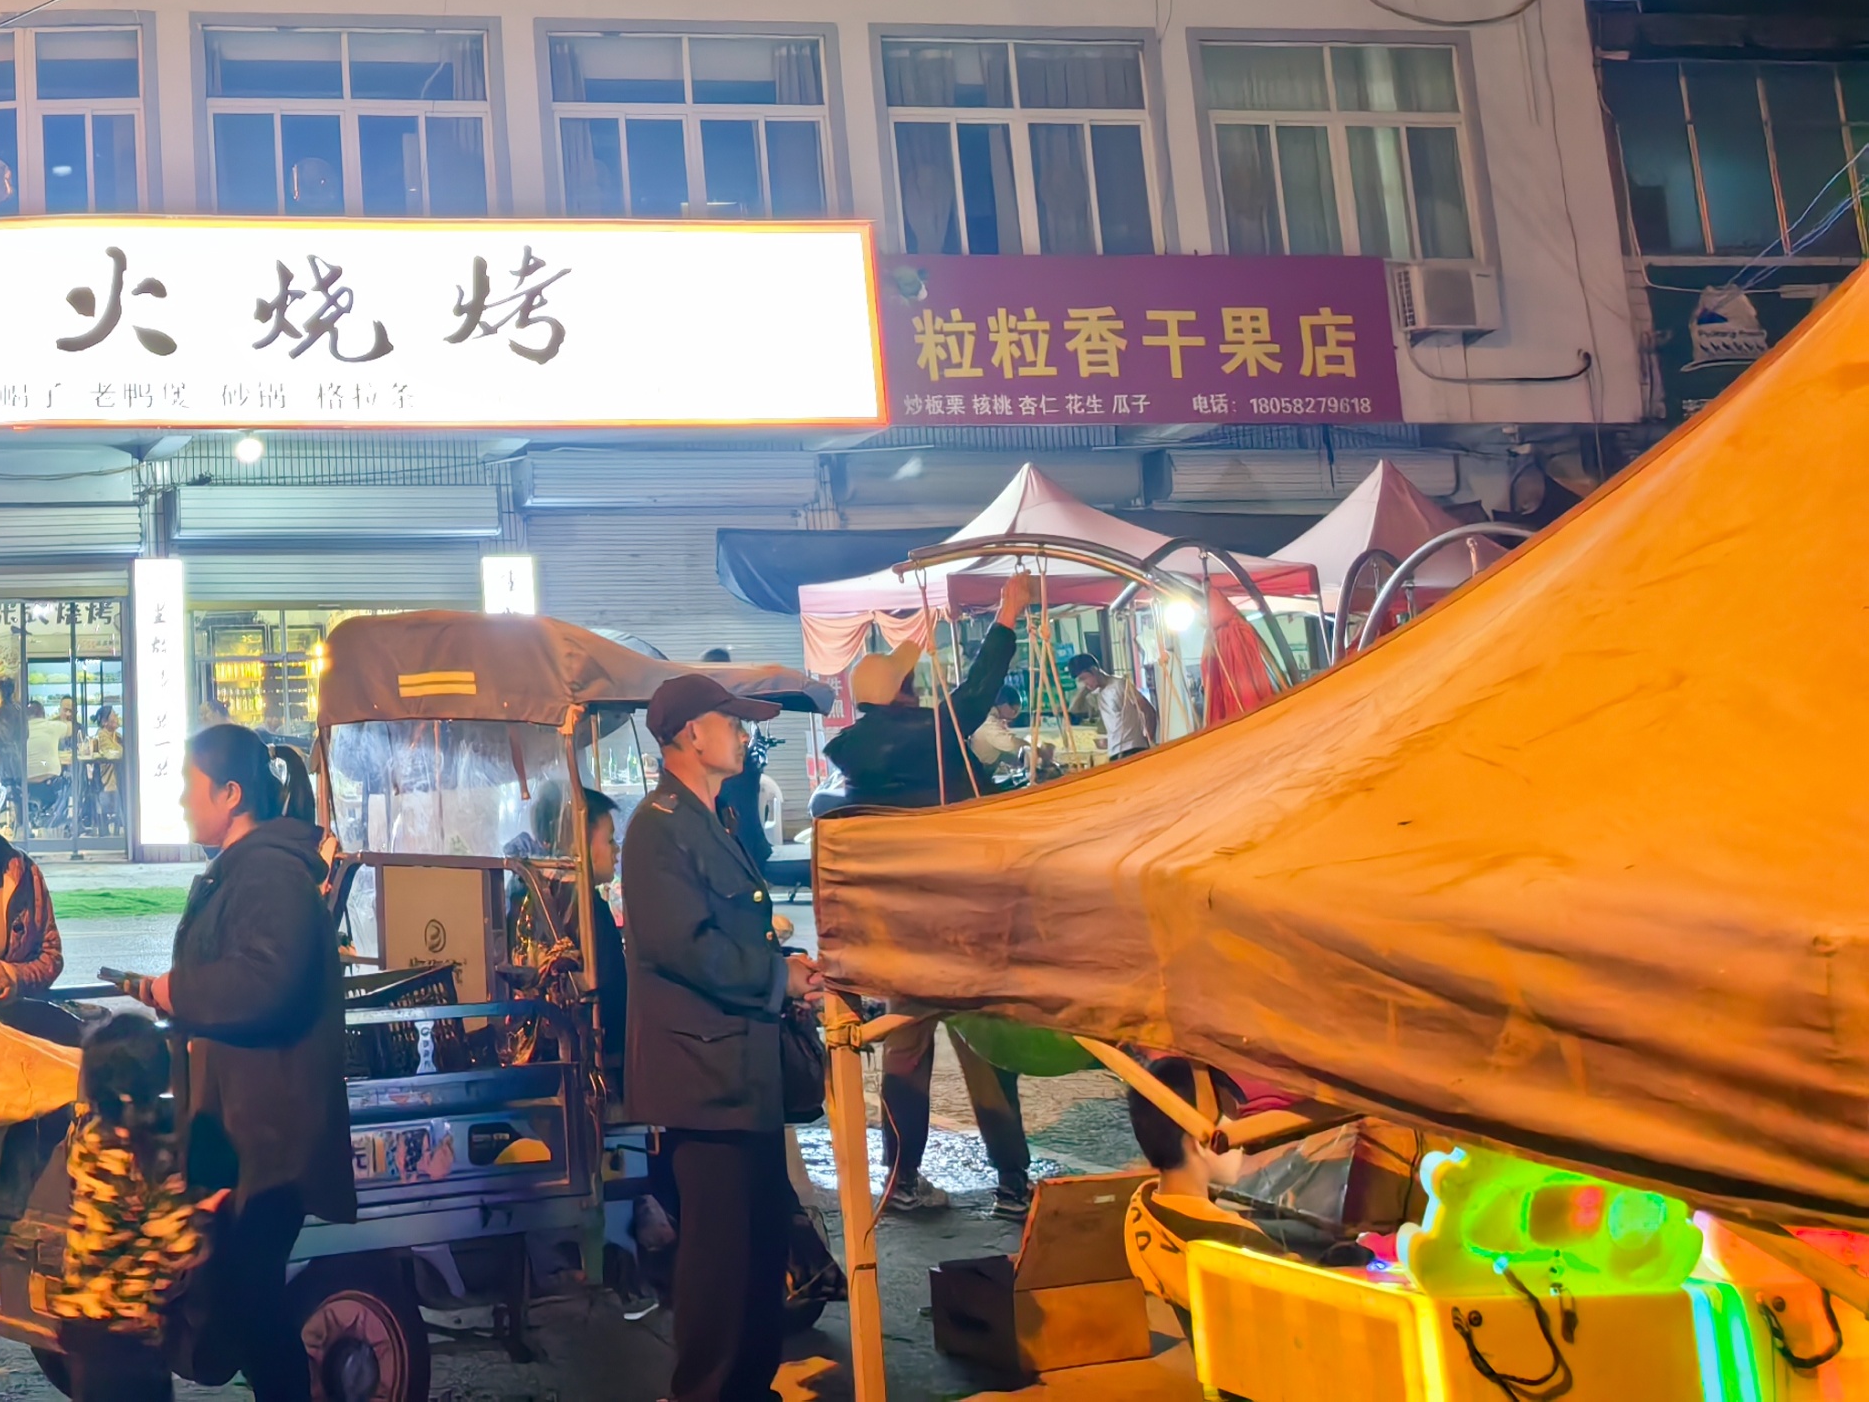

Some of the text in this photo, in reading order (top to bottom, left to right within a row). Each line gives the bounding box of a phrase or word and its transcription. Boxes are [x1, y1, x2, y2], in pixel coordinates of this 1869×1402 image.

[913, 306, 1357, 380] 粒粒香干果店
[903, 393, 966, 416] 炒板栗
[971, 393, 1014, 416] 核桃
[1018, 393, 1060, 416] 杏仁
[1064, 393, 1106, 415] 花生
[1111, 393, 1151, 414] 瓜子
[1249, 397, 1372, 415] 18058279618
